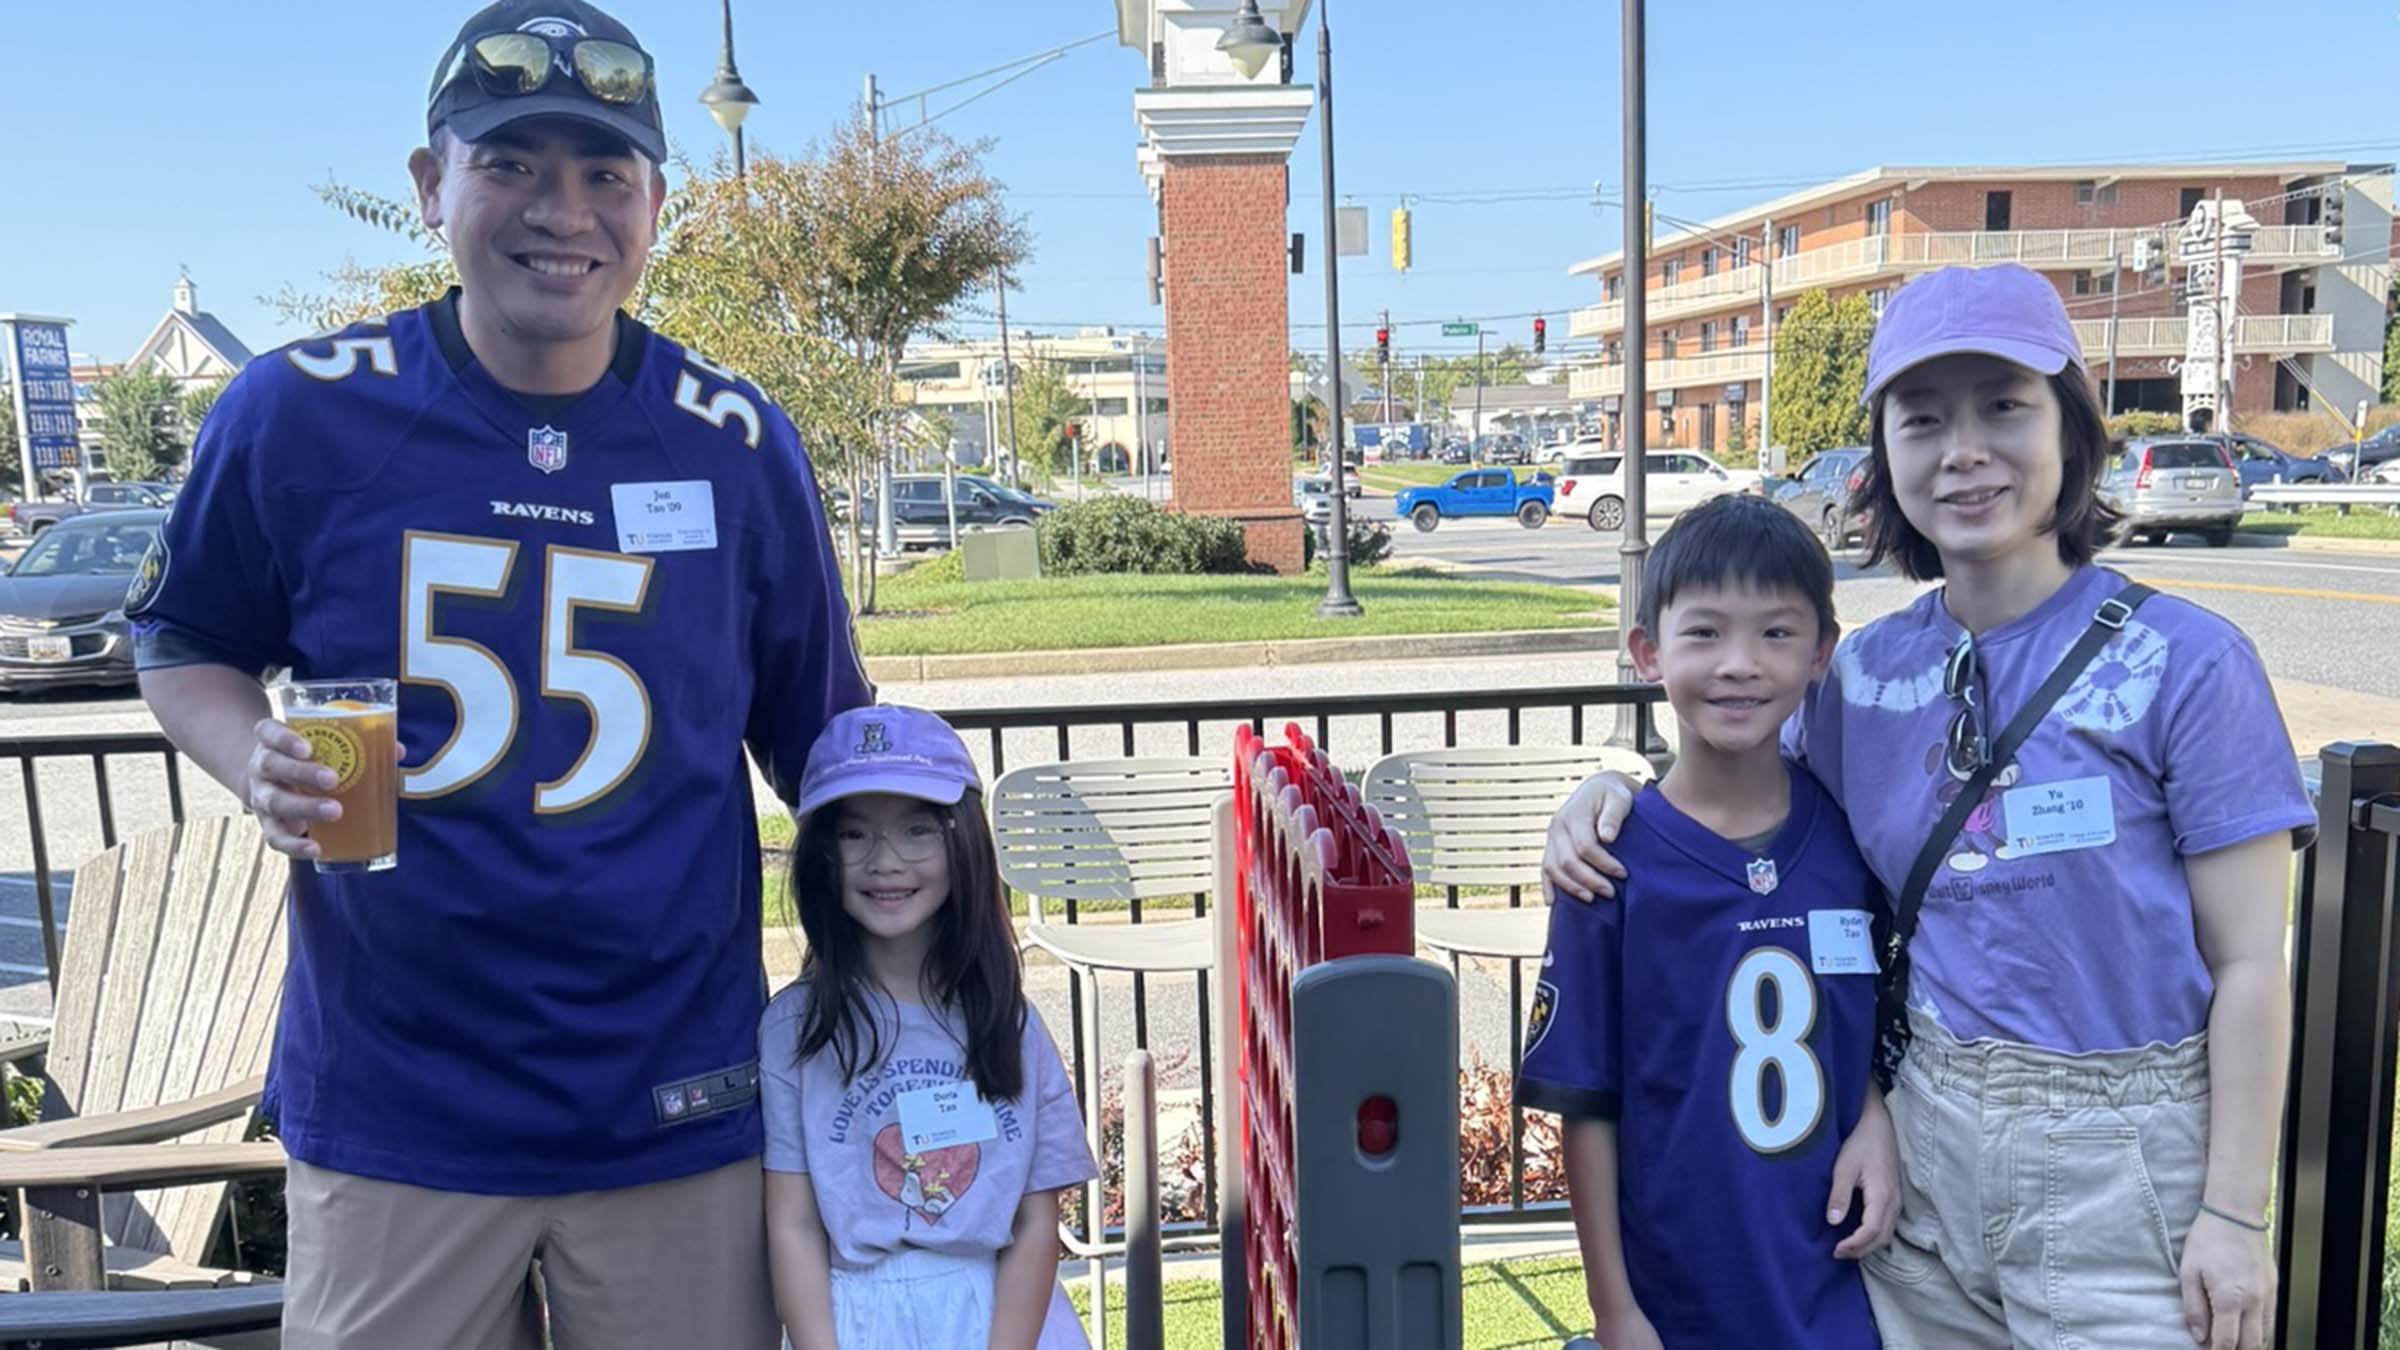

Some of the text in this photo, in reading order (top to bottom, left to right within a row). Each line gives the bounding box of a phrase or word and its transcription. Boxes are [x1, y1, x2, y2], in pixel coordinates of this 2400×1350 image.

[22, 329, 64, 348] ROYAL
[24, 348, 67, 368] FARMS
[534, 445, 563, 466] NFL
[489, 501, 595, 525] RAVENS
[399, 529, 655, 814] 55
[2048, 790, 2064, 800] Yu
[2032, 800, 2084, 817] Zhang '10
[2011, 873, 2055, 892] World
[1737, 917, 1804, 931] RAVENS
[1726, 945, 1825, 1153] 8
[724, 1076, 736, 1089] L
[829, 1089, 861, 1144] LOVE
[858, 1072, 880, 1096] IS
